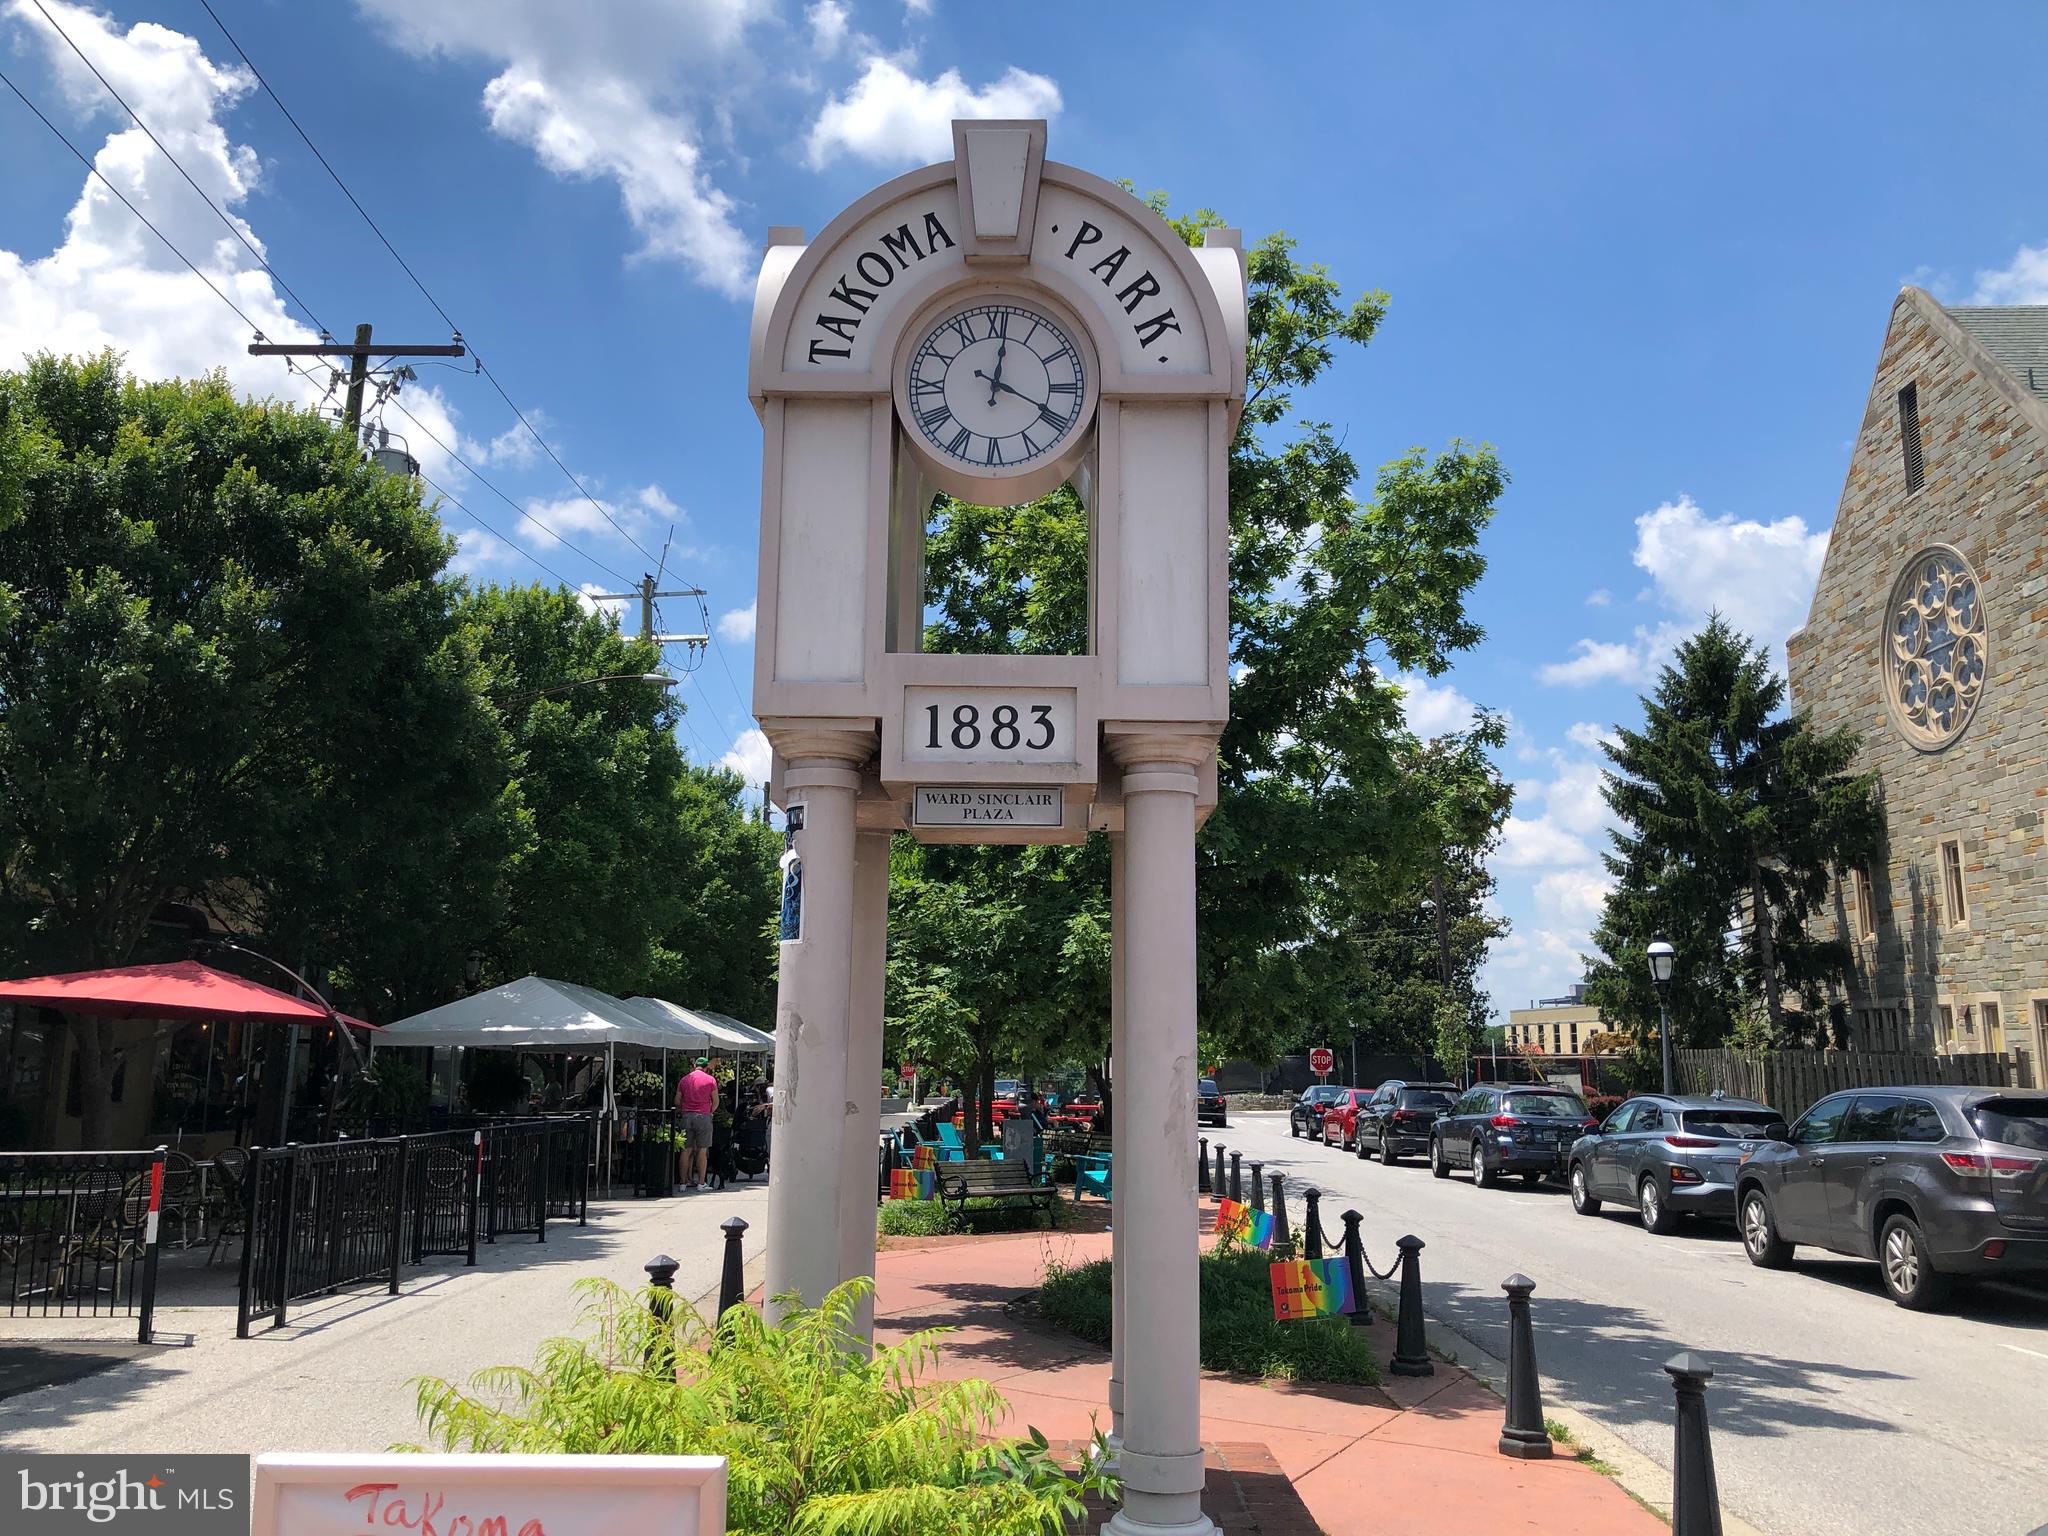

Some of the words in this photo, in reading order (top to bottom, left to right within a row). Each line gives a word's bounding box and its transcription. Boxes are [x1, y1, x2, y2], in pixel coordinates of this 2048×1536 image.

[808, 212, 955, 364] TAKOMA
[925, 704, 1055, 750] 1883
[926, 793, 972, 805] WARD
[978, 793, 1053, 806] SINCLAIR
[963, 808, 1014, 820] PLAZA
[1312, 1055, 1332, 1065] STOP
[1277, 1286, 1303, 1295] Takoma
[1304, 1283, 1323, 1293] Pride
